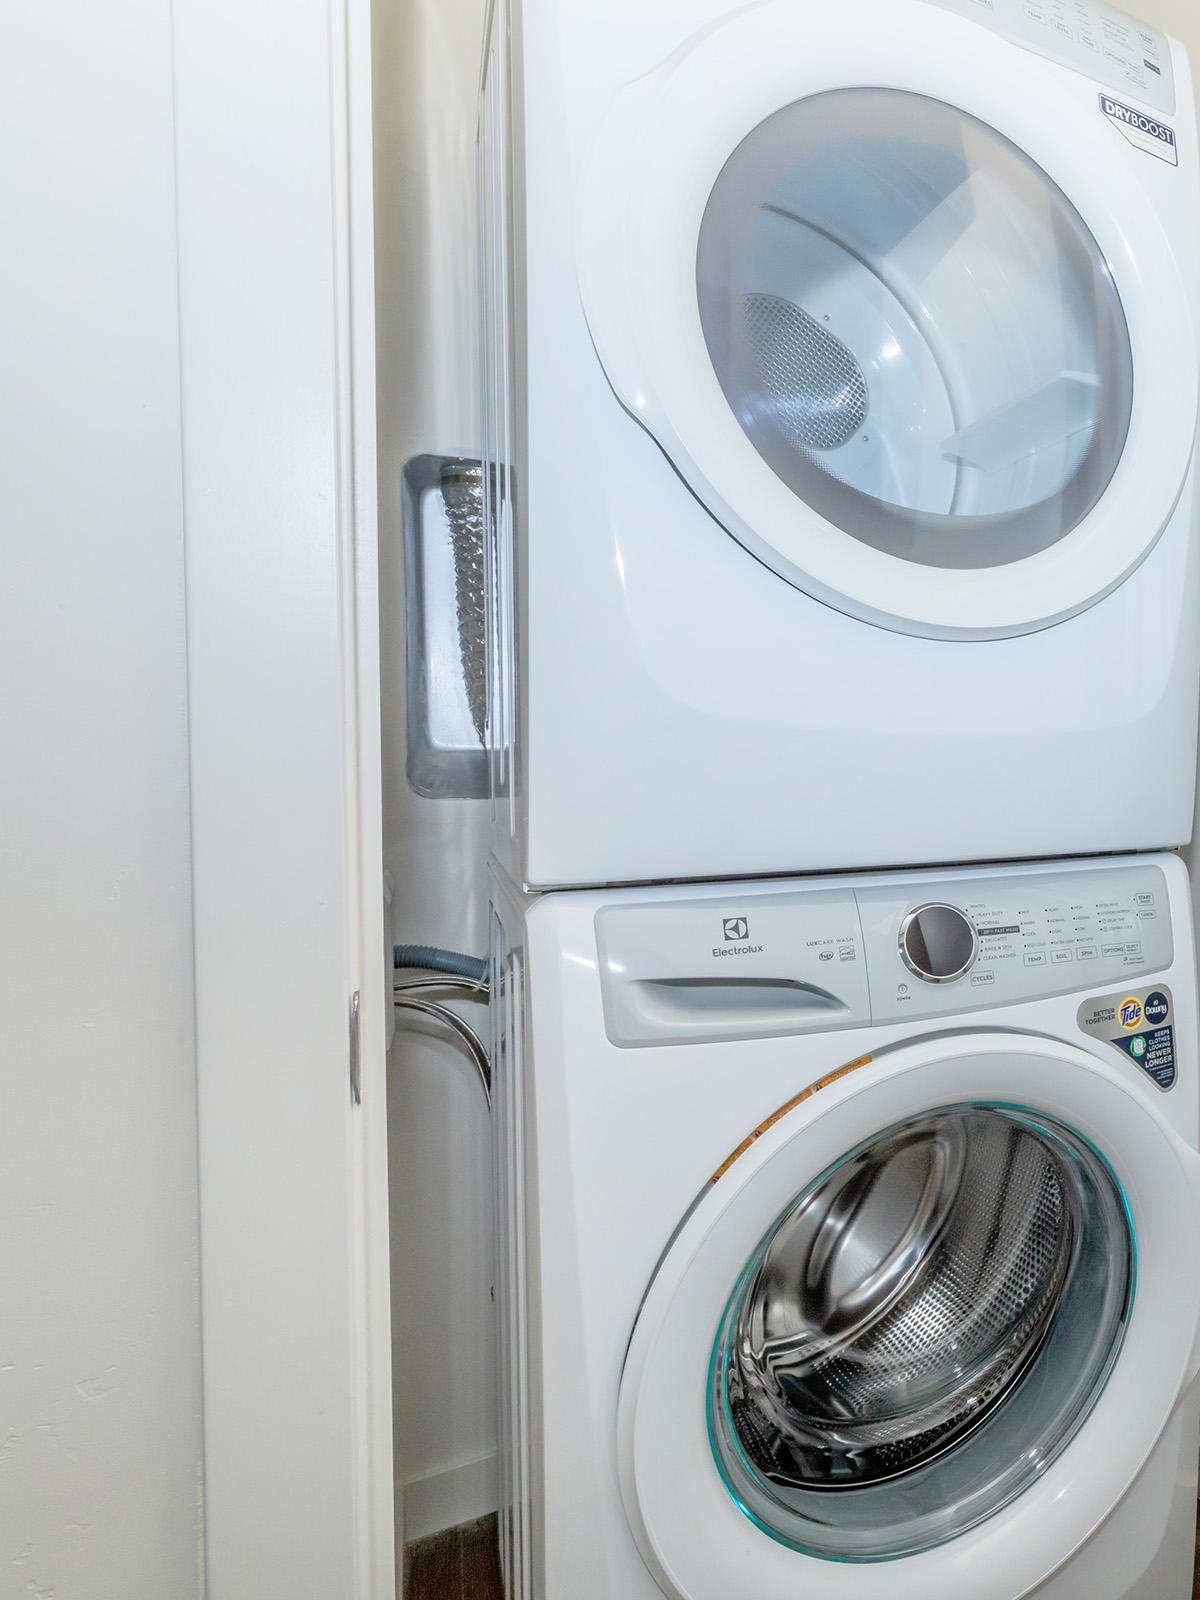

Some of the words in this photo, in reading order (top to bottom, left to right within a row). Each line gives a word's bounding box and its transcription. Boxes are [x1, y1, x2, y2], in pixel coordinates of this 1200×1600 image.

[1105, 100, 1171, 142] DRYBOOST
[712, 945, 764, 957] Electrolux
[1093, 1007, 1115, 1018] BETTER
[1120, 1004, 1142, 1026] Tide
[1145, 1003, 1167, 1015] Downy
[1085, 1013, 1116, 1026] TOGETHER
[1154, 1029, 1170, 1037] KEEPS
[1148, 1035, 1170, 1046] CLOTHES
[1149, 1041, 1171, 1051] LOOKING
[1147, 1047, 1172, 1060] NEWER
[1145, 1055, 1173, 1069] LONGER
